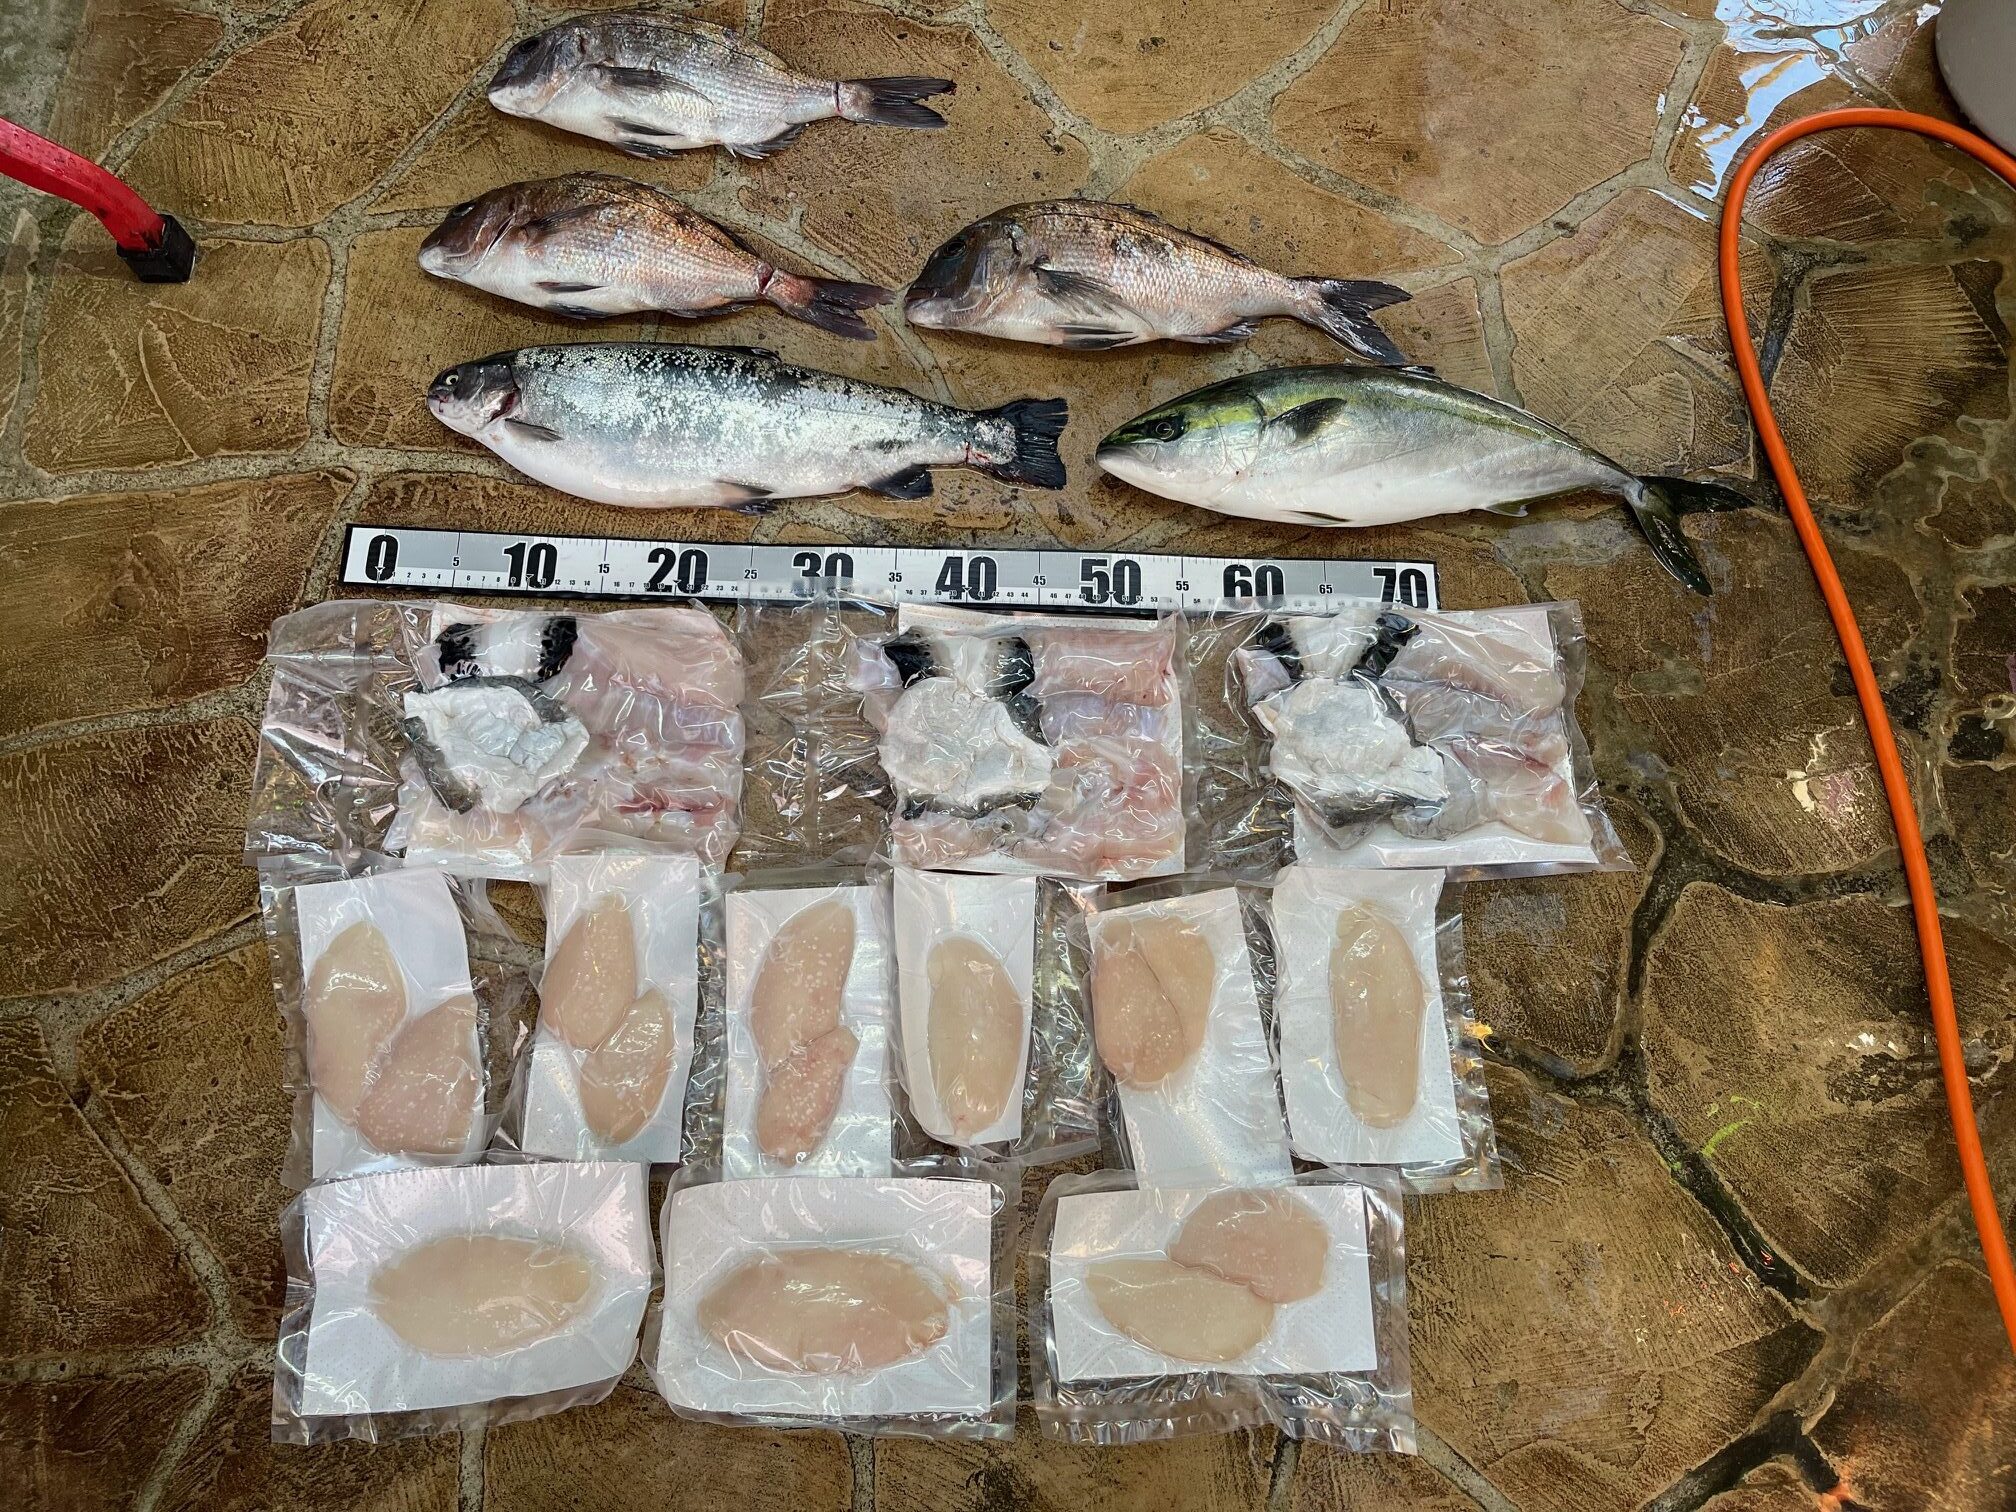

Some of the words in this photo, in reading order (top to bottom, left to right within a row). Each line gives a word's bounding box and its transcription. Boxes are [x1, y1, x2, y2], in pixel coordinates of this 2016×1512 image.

[365, 534, 399, 581] 0
[503, 542, 558, 589] 10
[647, 547, 709, 594] 20
[792, 551, 854, 598] 30
[935, 556, 997, 601] 40
[1080, 558, 1142, 605] 50
[1222, 563, 1285, 609] 60
[1373, 567, 1429, 608] 70
[452, 556, 460, 567] 5
[598, 563, 610, 574] 15
[744, 569, 758, 580] 25
[888, 572, 903, 582] 35
[1033, 575, 1047, 586] 45
[1175, 580, 1190, 591] 55
[1319, 584, 1333, 594] 65
